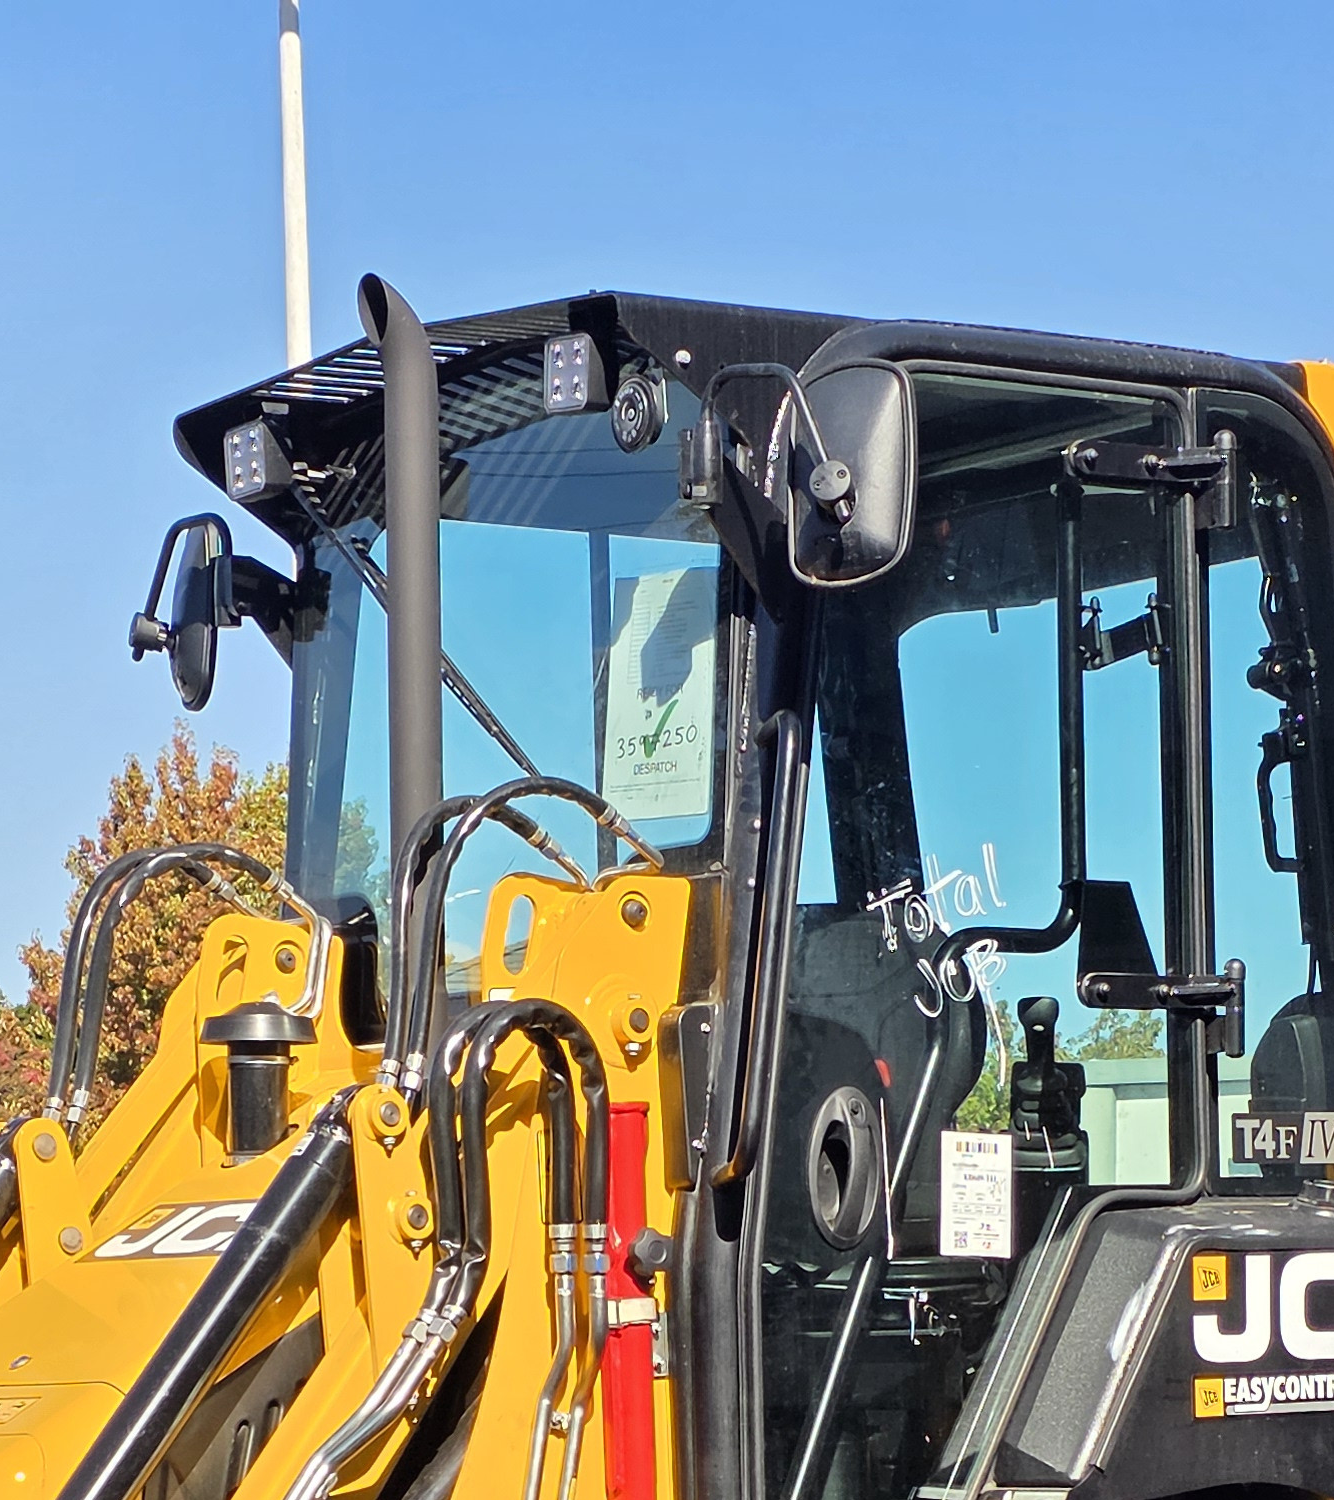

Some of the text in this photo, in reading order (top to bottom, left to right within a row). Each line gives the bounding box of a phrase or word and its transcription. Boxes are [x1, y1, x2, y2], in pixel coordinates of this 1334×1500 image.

[633, 760, 678, 776] DESPATCH
[94, 1202, 259, 1258] JC
[1202, 1269, 1220, 1289] JCB
